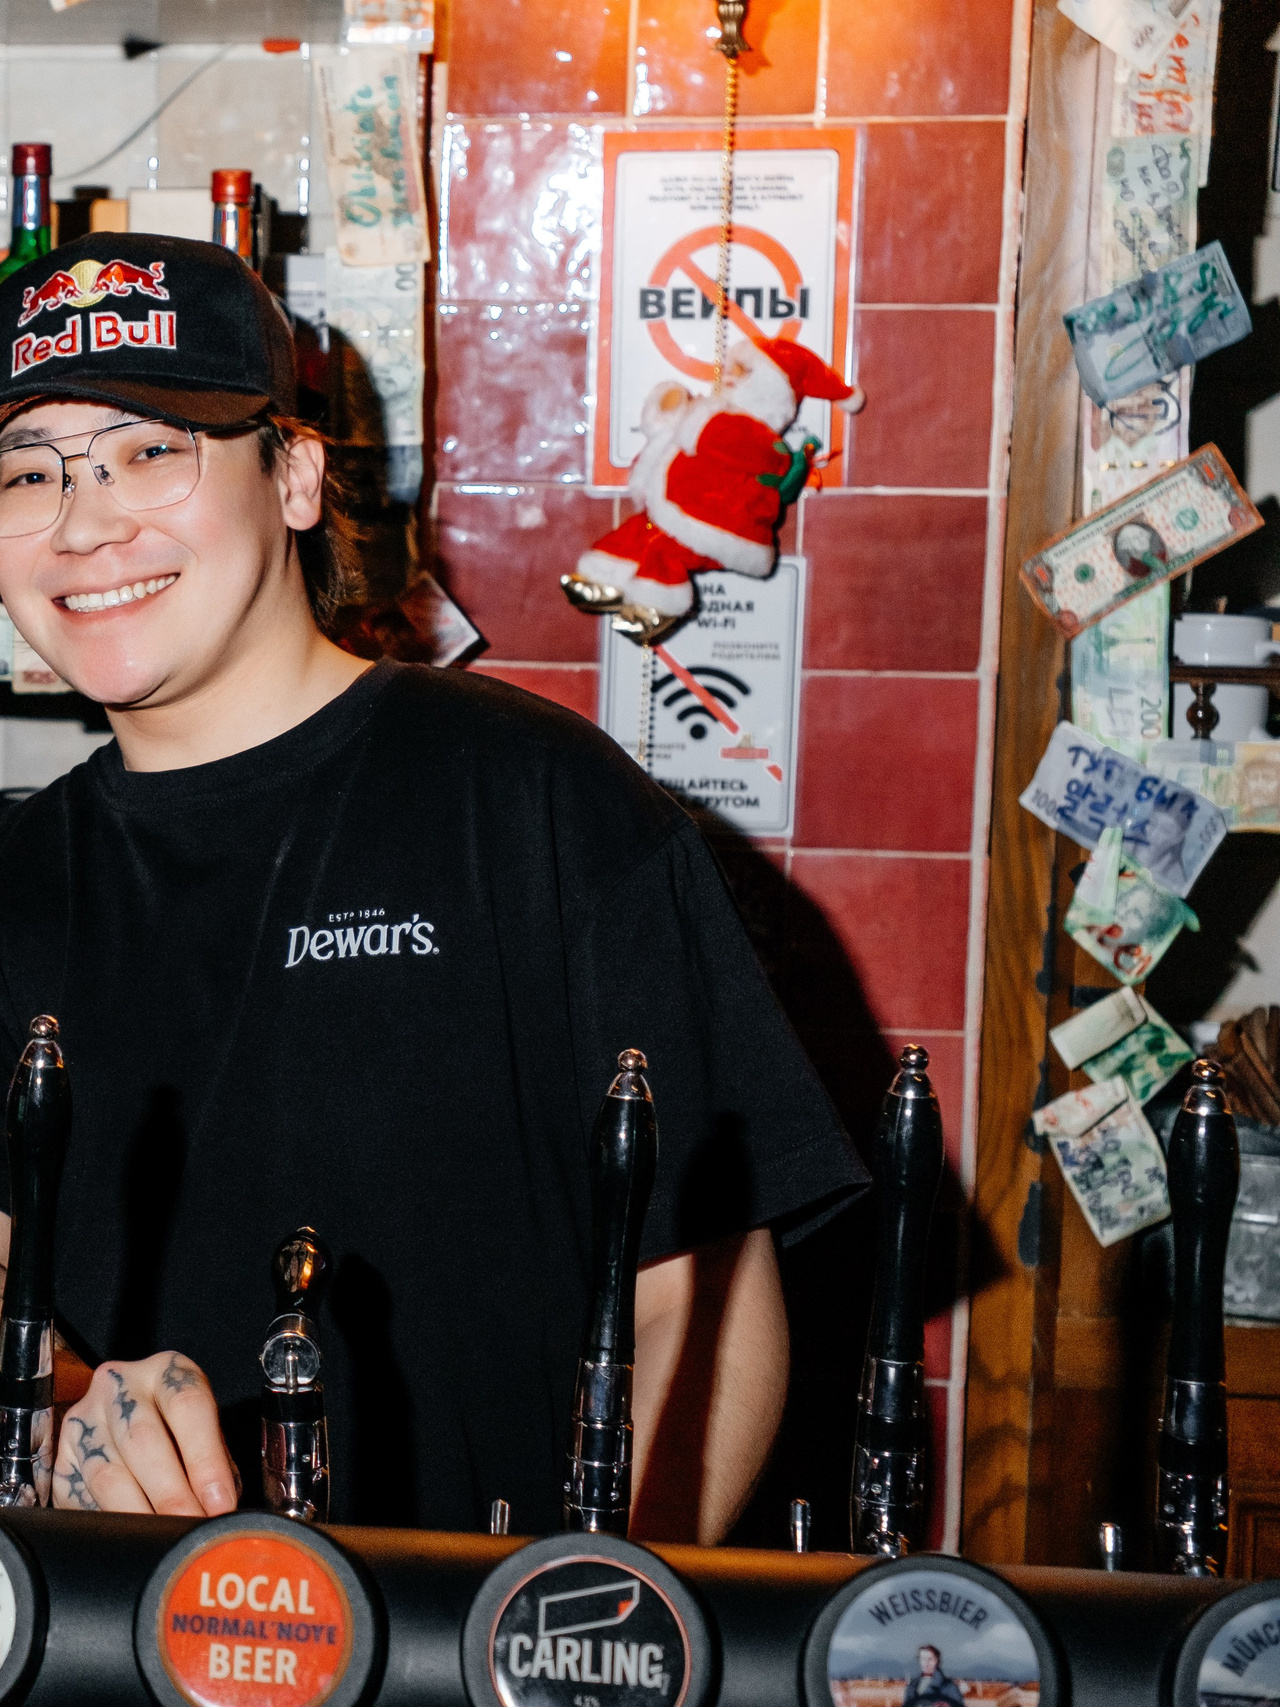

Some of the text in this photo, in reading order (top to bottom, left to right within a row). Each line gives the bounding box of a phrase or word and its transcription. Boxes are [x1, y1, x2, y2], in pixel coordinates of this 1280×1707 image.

[12, 311, 176, 375] Red Bull
[1141, 697, 1162, 739] 200
[359, 908, 385, 918] 1846
[285, 913, 436, 968] Dewar's
[199, 1571, 316, 1615] LOCAL
[869, 1589, 988, 1630] WEISSBIER
[208, 1642, 298, 1686] BEER
[509, 1633, 664, 1689] CARLING
[1222, 1619, 1280, 1677] MÜNC
